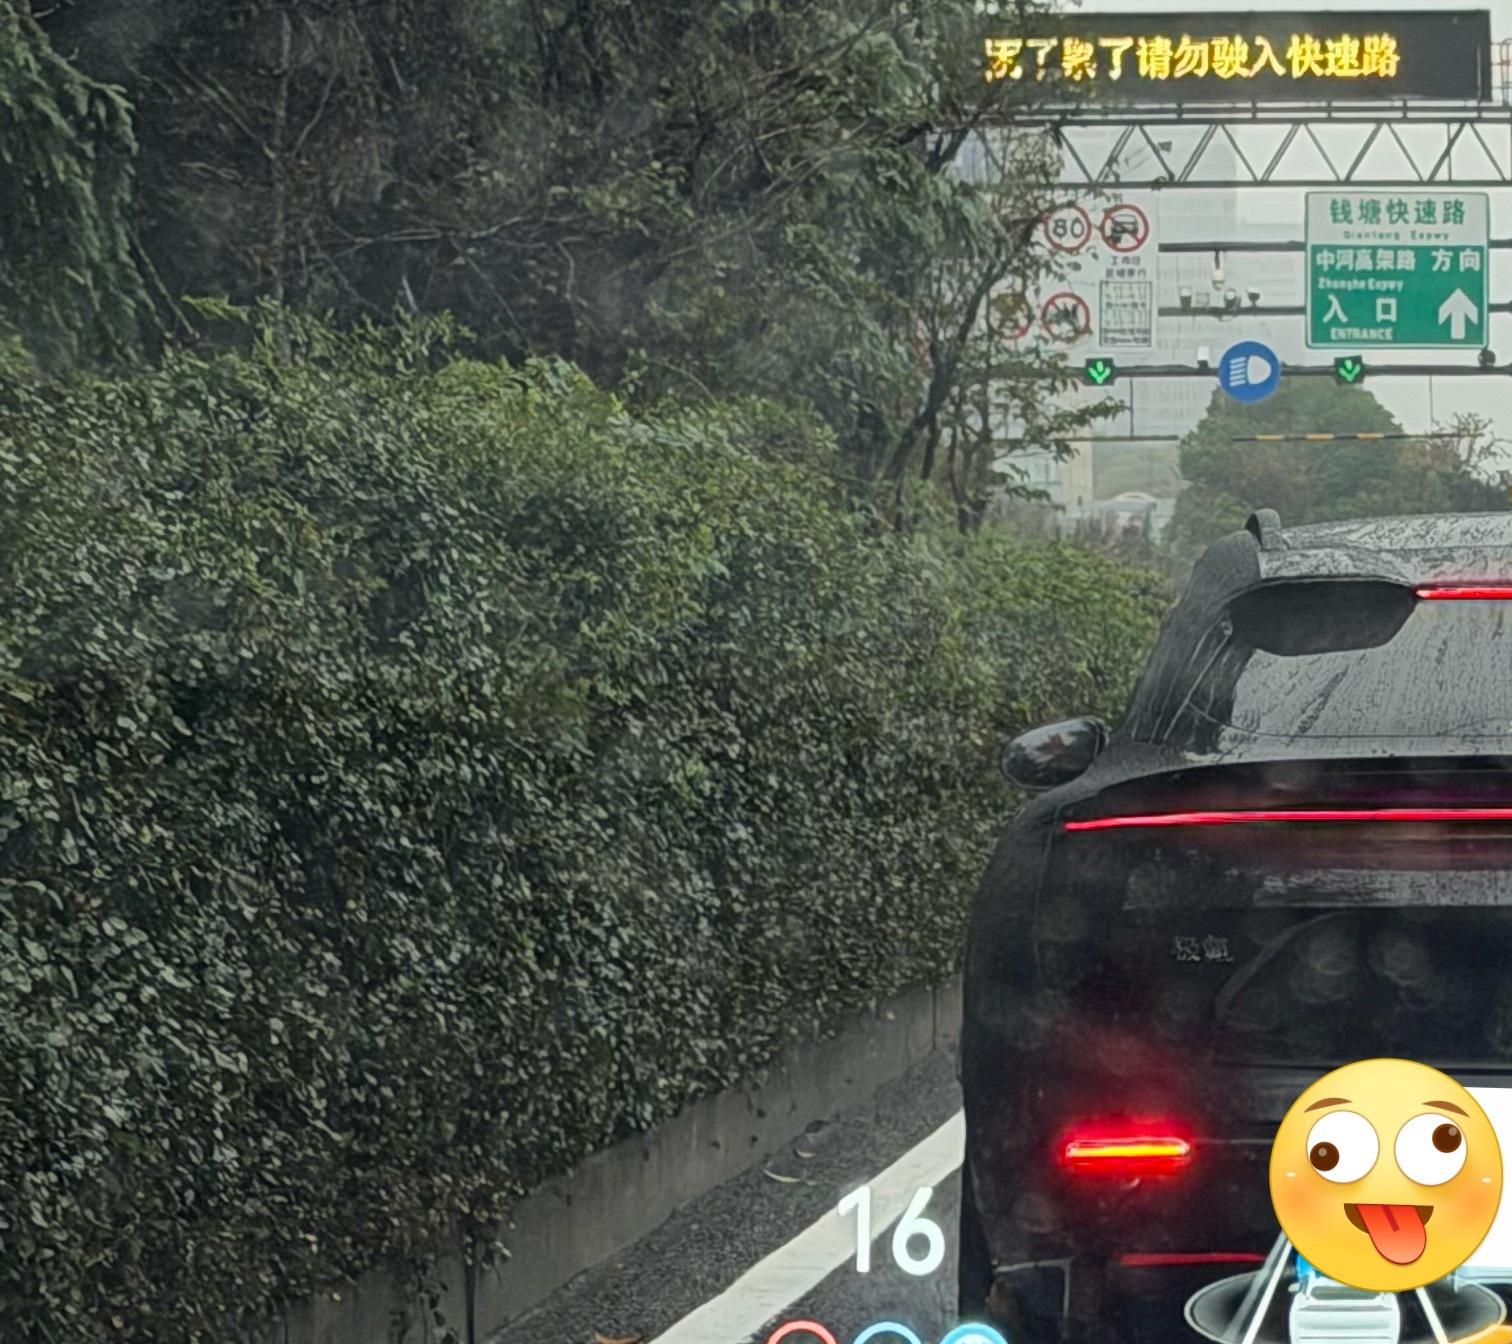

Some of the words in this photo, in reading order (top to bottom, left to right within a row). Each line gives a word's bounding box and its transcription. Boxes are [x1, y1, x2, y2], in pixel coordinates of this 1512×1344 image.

[1329, 198, 1465, 224] 钱塘快速路
[1316, 248, 1416, 272] 中河高架路
[1431, 249, 1481, 272] 方向
[1322, 294, 1397, 323] 入口
[1330, 327, 1393, 341] ENTRANCE
[837, 1185, 946, 1276] 16
